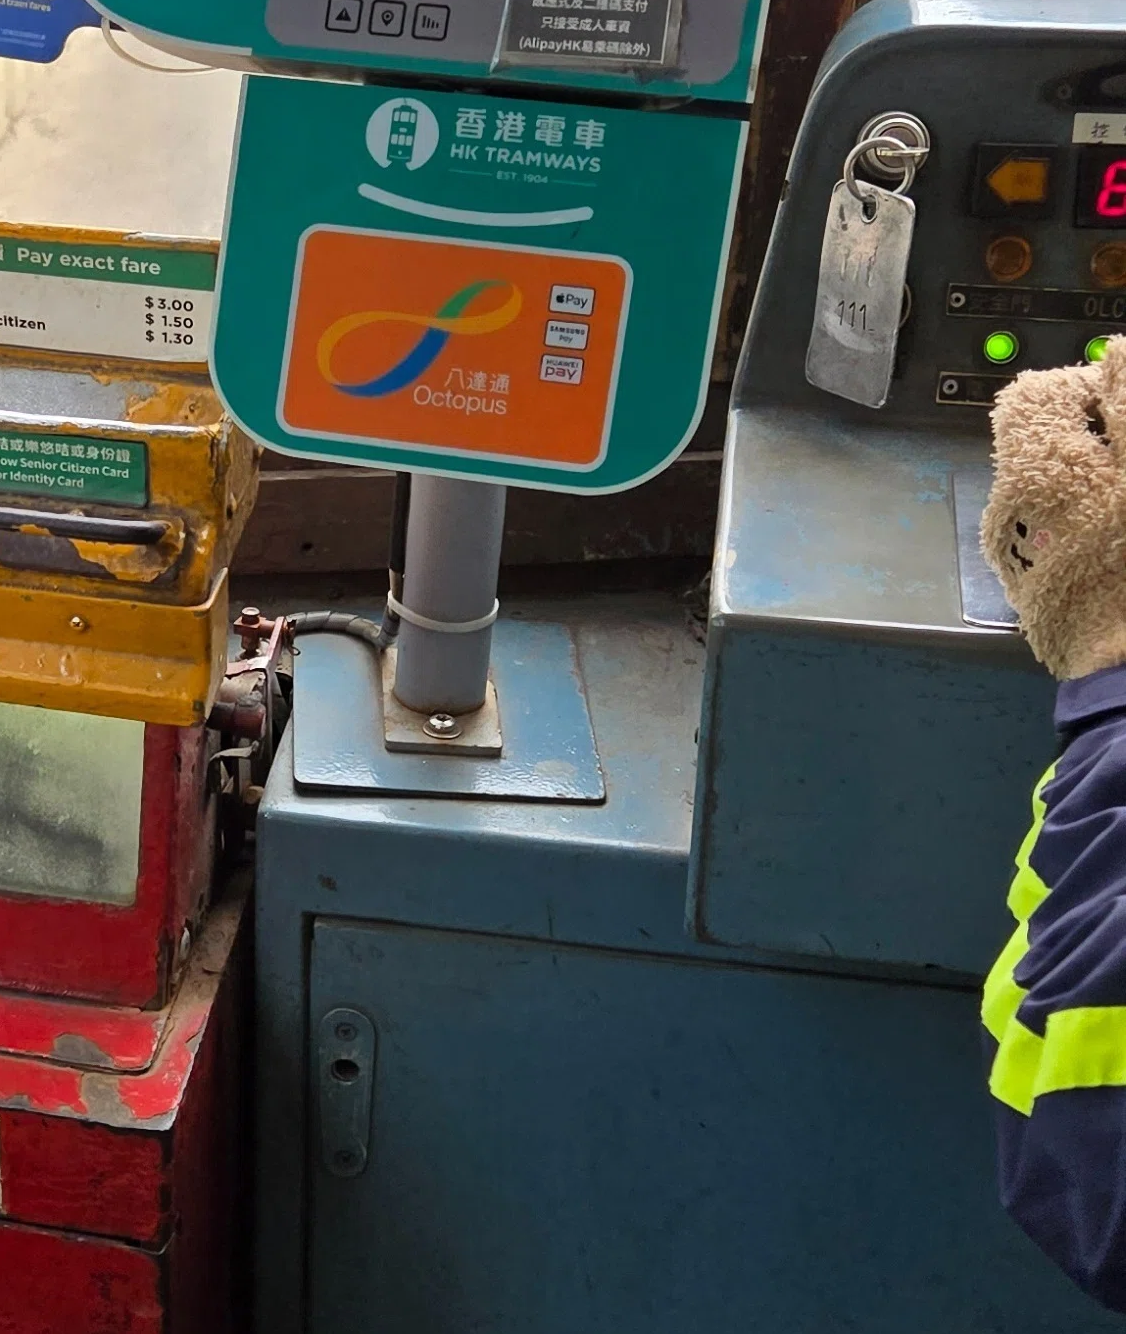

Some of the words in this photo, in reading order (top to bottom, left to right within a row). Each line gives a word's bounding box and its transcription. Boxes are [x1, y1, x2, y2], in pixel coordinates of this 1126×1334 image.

[454, 107, 606, 150] 香港電車
[450, 143, 478, 161] HK
[485, 147, 601, 173] TRAMWAYS
[496, 170, 520, 182] EST.
[522, 172, 549, 184] 1904
[17, 247, 53, 268] Pay
[59, 252, 115, 271] exact
[120, 256, 161, 276] fare
[565, 293, 588, 309] Pay
[550, 325, 585, 335] SAMSUNG
[546, 358, 579, 368] HUAWEI
[444, 367, 511, 395] 八達通
[413, 384, 508, 416] Octopus
[20, 457, 58, 471] Senior
[60, 461, 100, 475] Citizen
[102, 466, 129, 479] Card
[10, 471, 55, 487] Identity
[57, 475, 84, 488] Card
